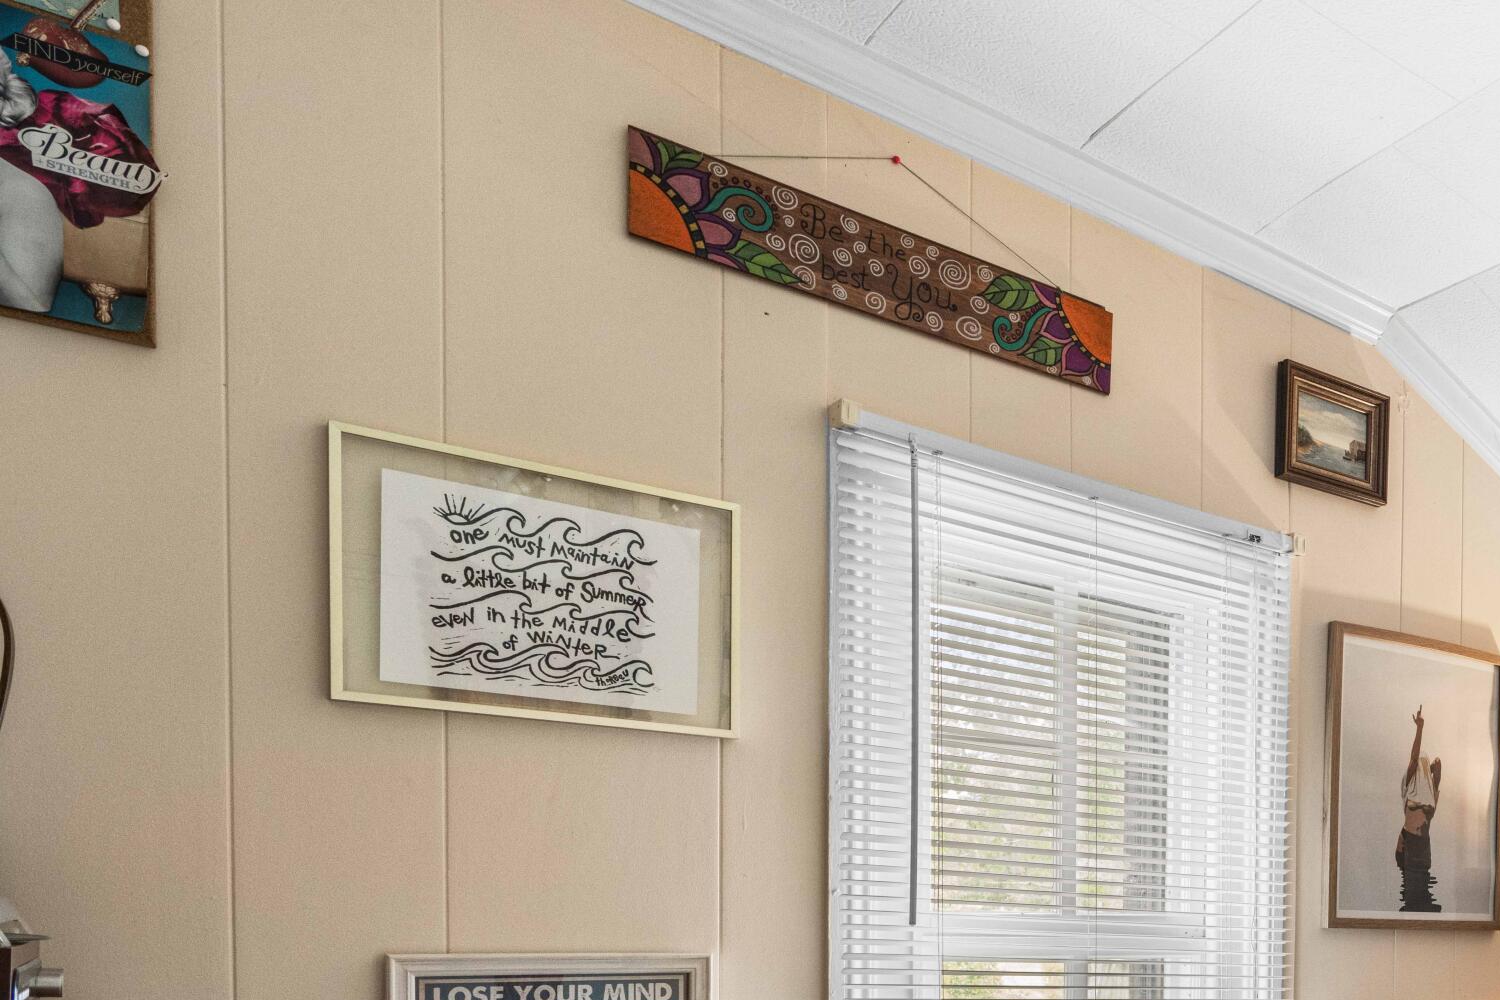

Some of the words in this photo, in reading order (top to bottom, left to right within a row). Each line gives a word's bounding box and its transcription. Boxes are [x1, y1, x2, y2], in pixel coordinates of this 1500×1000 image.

[14, 33, 71, 64] FIND
[72, 58, 145, 84] yourself
[46, 160, 130, 189] STRENGTH
[800, 203, 844, 243] Be
[864, 229, 906, 261] the
[820, 253, 871, 291] best
[449, 528, 489, 545] one
[441, 573, 456, 584] a
[462, 566, 517, 589] little
[522, 570, 551, 594] bit
[555, 582, 575, 601] of
[486, 606, 506, 623] in
[510, 610, 544, 629] the
[502, 634, 518, 651] of
